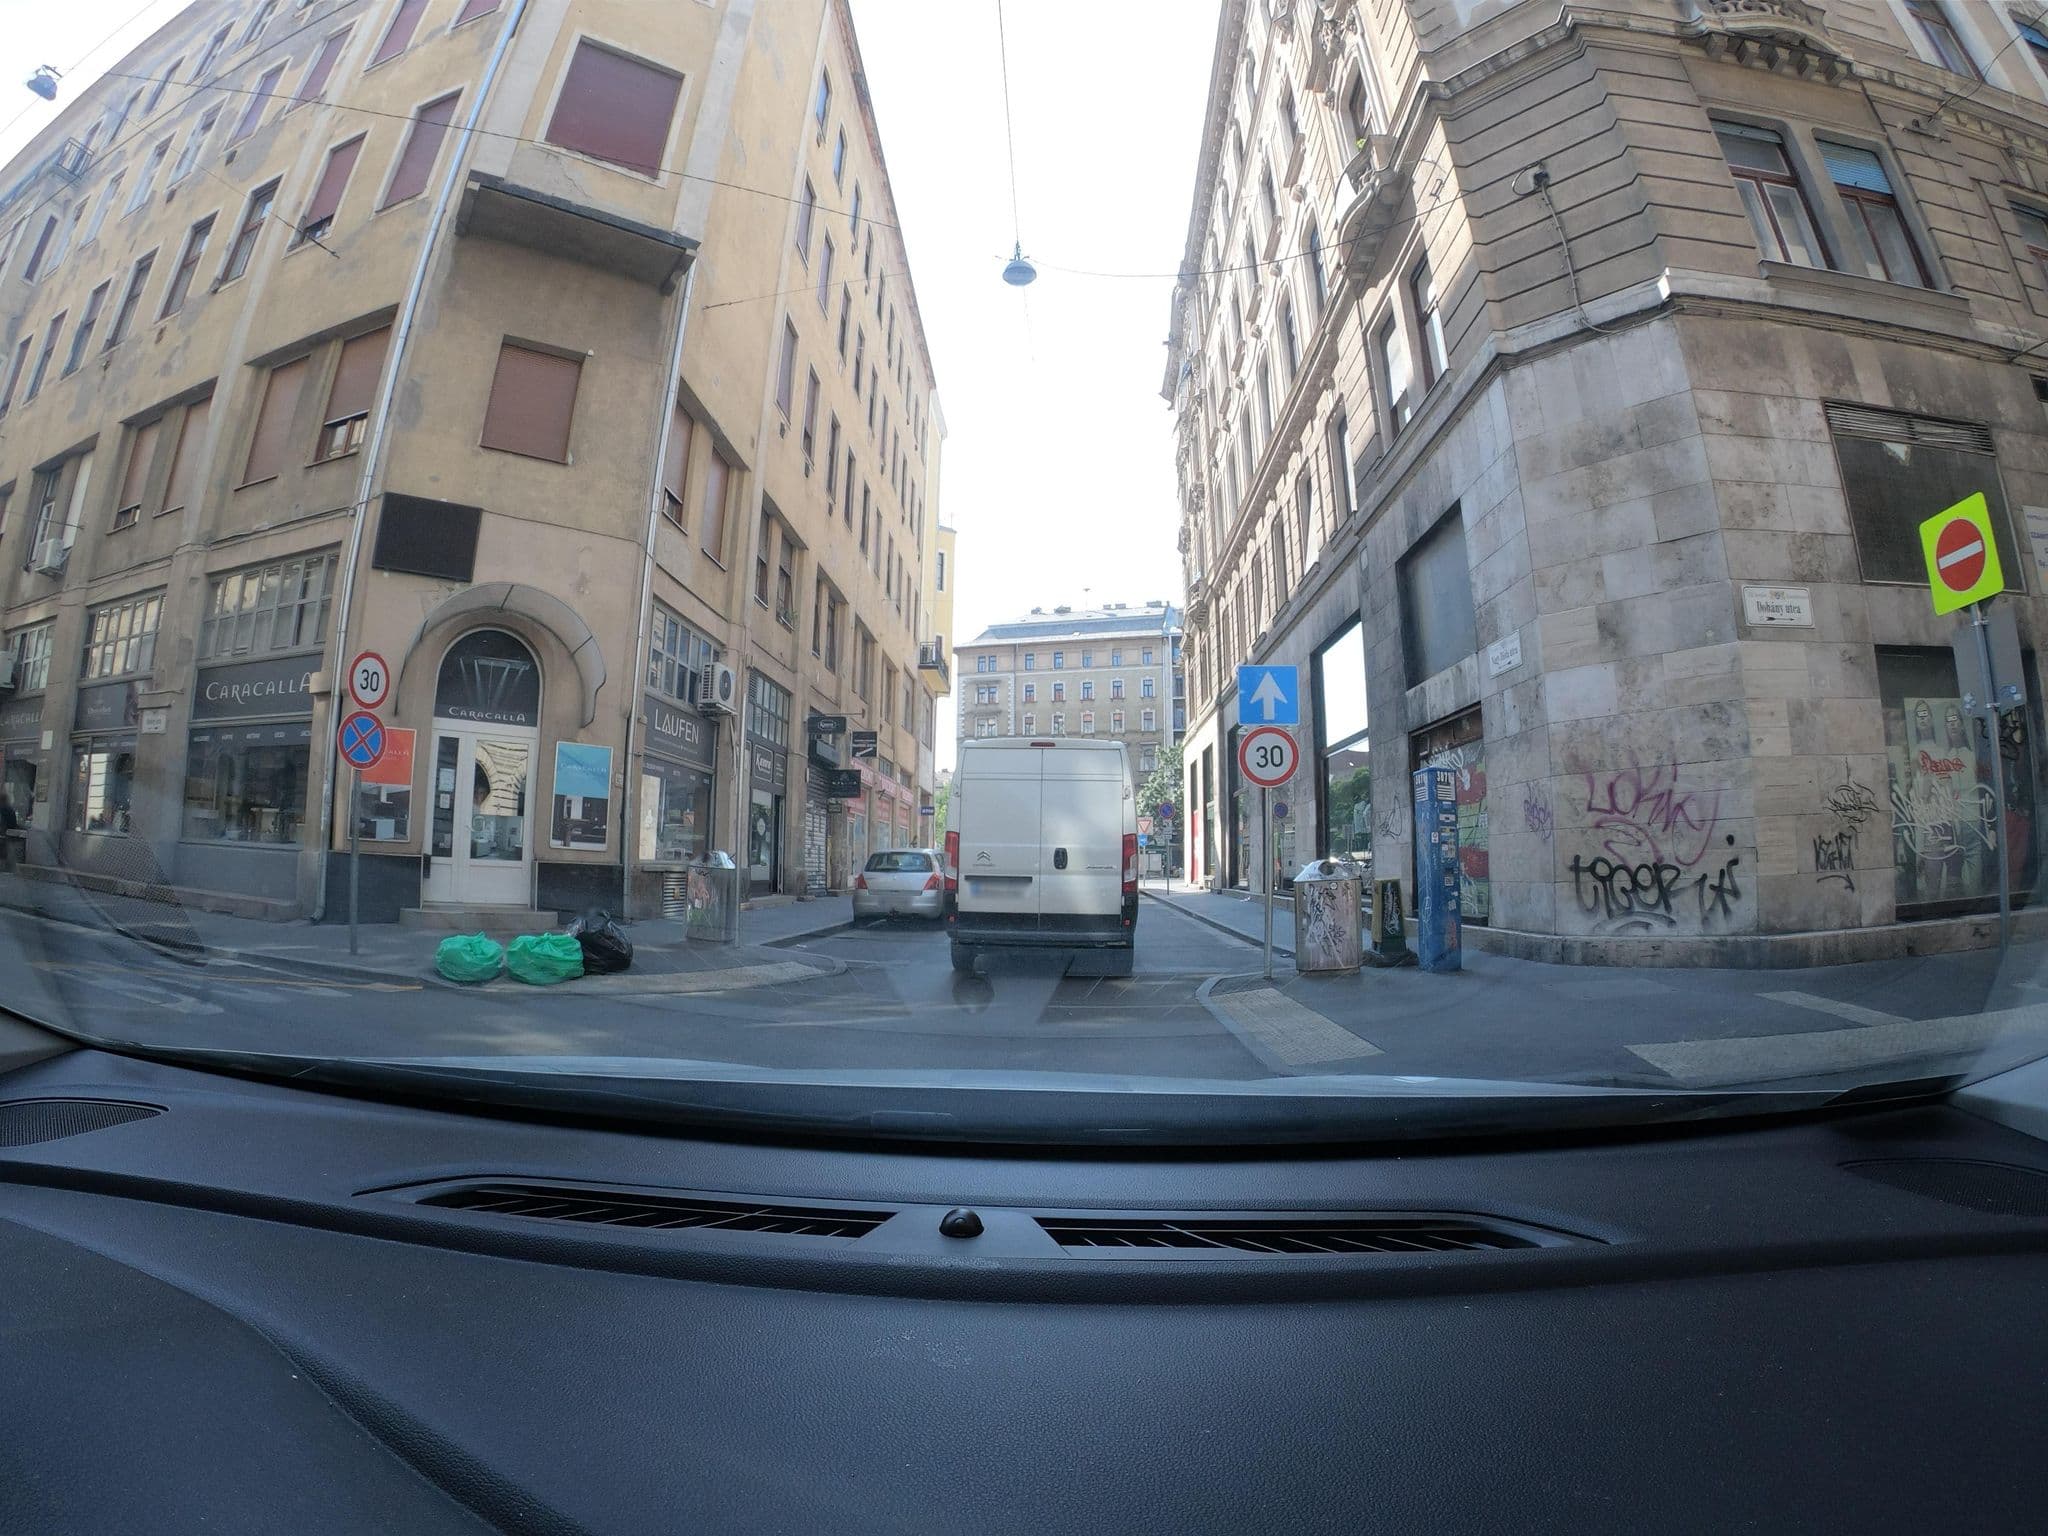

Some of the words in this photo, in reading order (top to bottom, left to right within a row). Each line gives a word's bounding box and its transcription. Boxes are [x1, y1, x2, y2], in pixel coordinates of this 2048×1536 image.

[360, 669, 380, 692] 30
[654, 708, 700, 745] LAUFEN
[1256, 745, 1283, 768] 30
